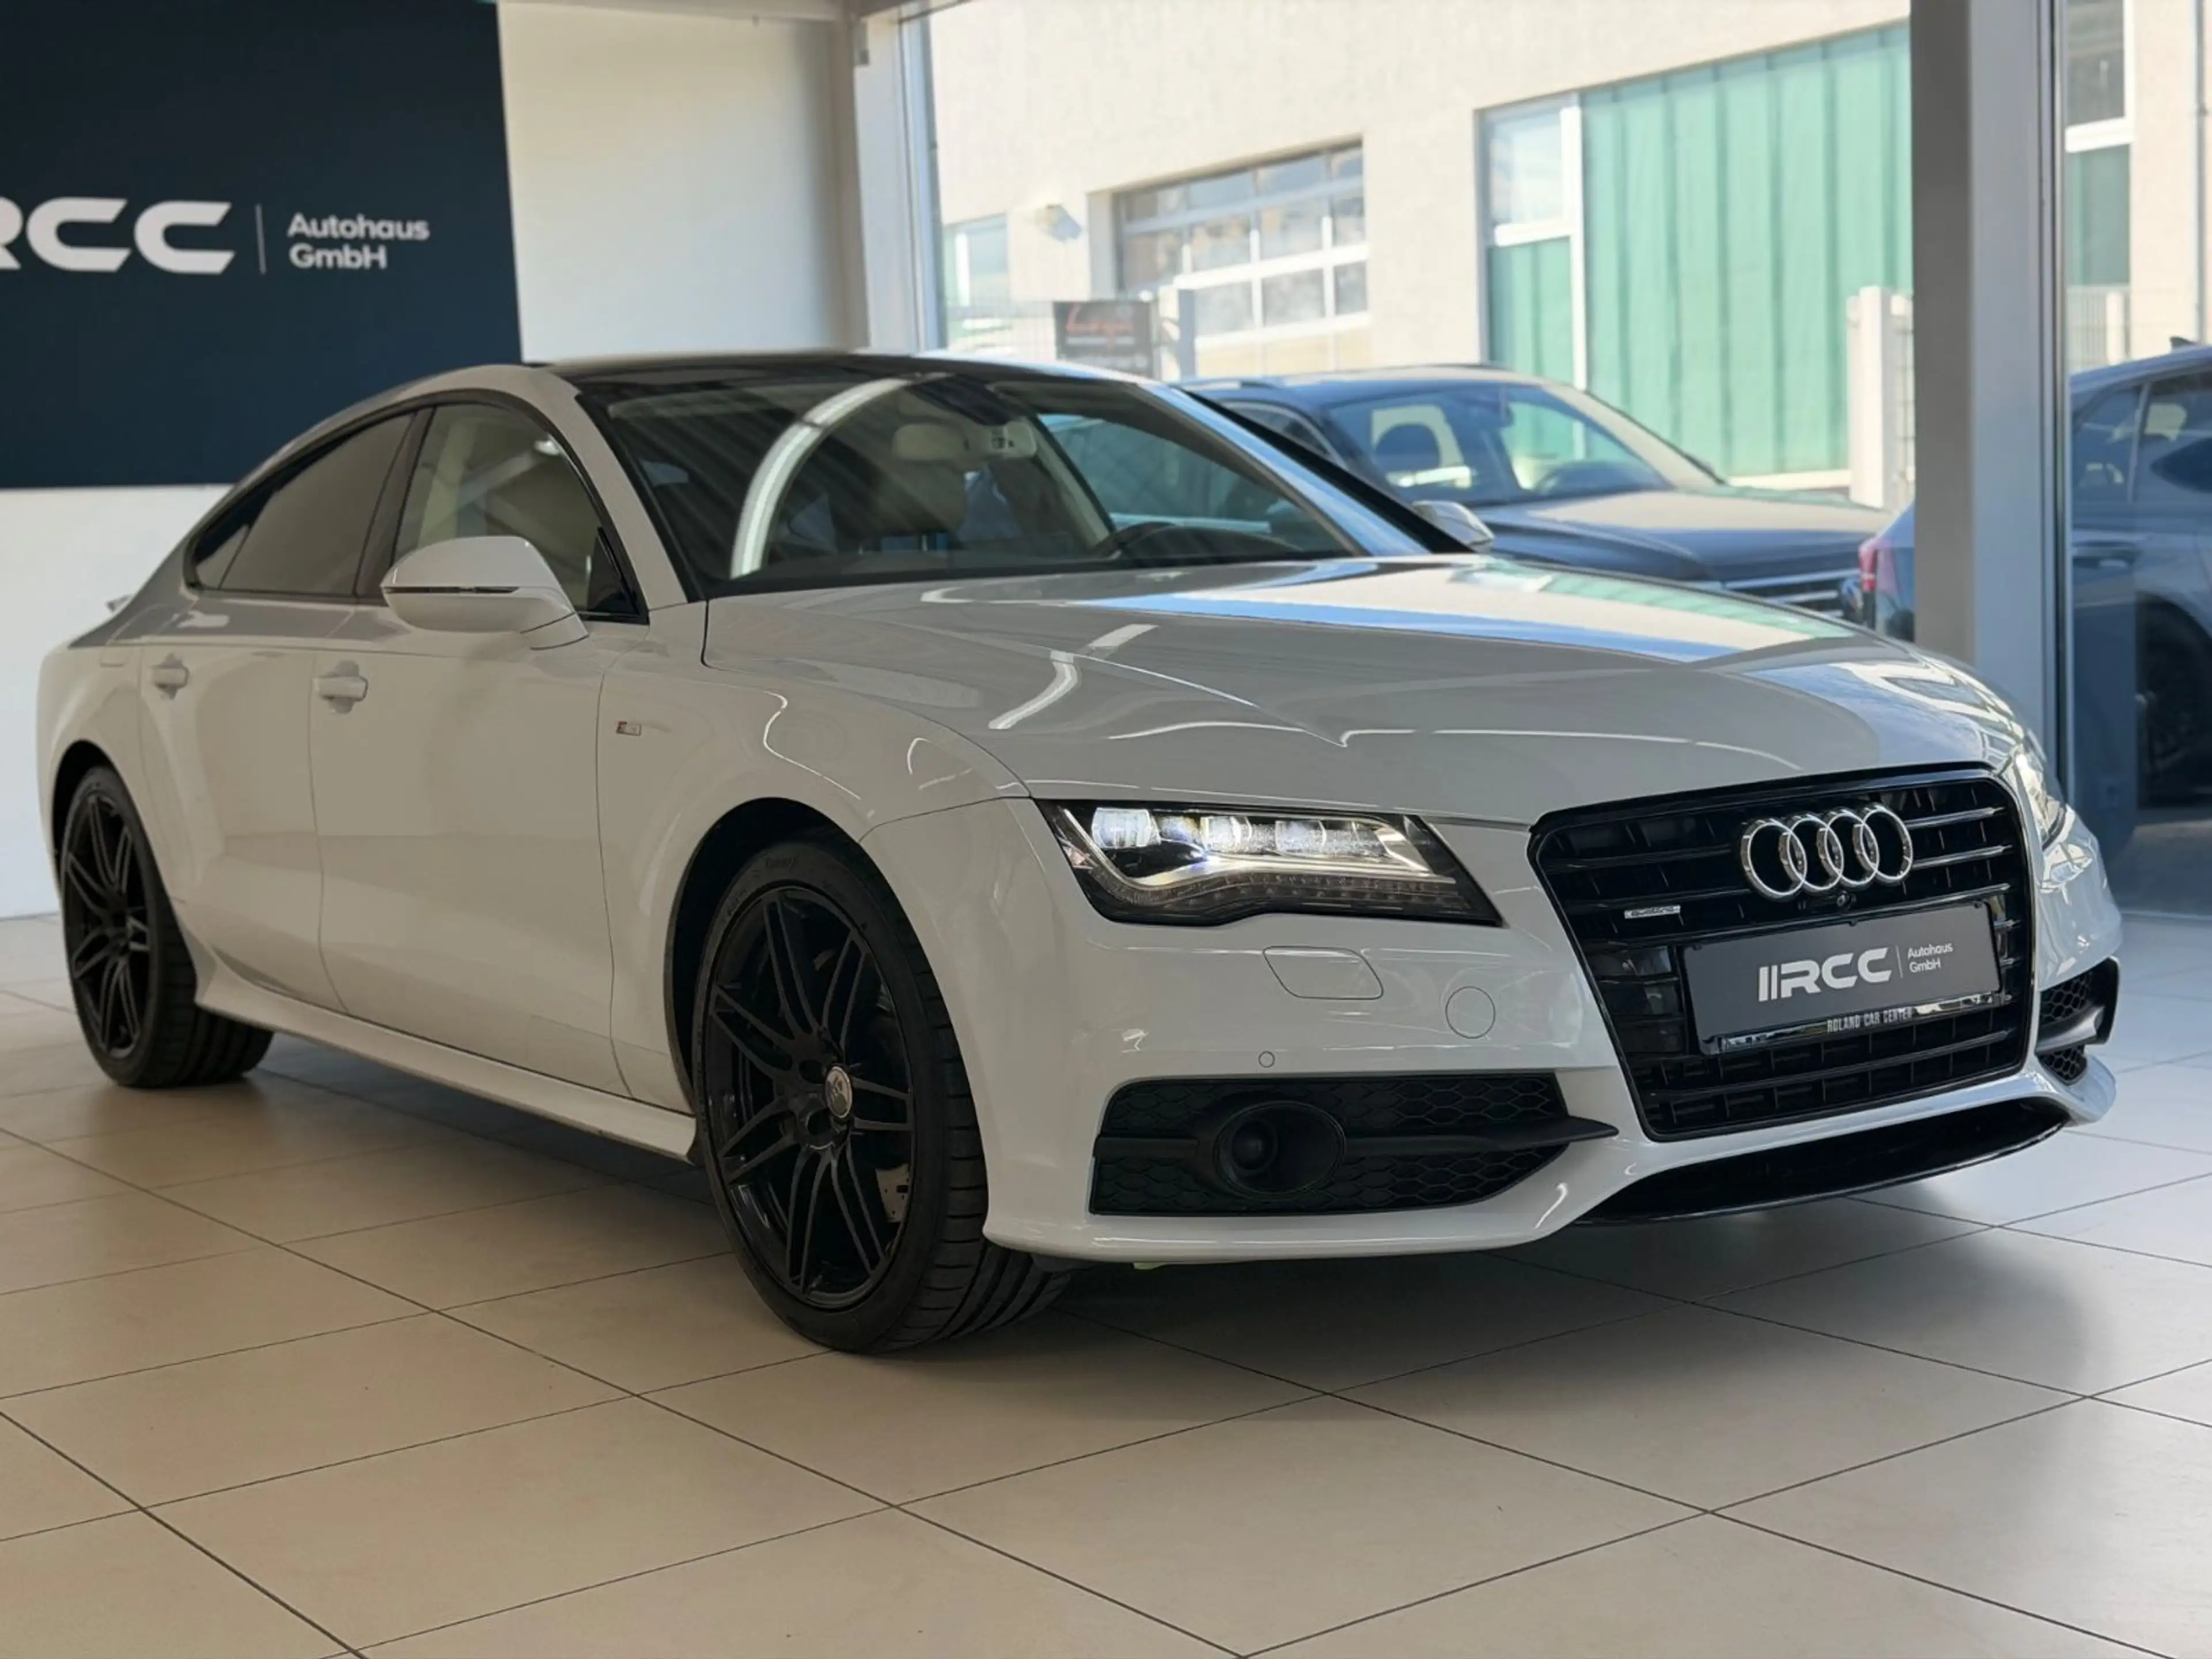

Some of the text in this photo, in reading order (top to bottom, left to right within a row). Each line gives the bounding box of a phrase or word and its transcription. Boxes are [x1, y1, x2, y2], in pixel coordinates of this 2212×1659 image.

[0, 196, 236, 275] CC
[286, 212, 430, 241] Autohaus
[289, 242, 387, 270] GmbH
[1907, 942, 1953, 960] Autohaus
[1909, 956, 1941, 972] GmbH
[1827, 1014, 1860, 1033] ROLAND
[1863, 1011, 1880, 1027] CAR
